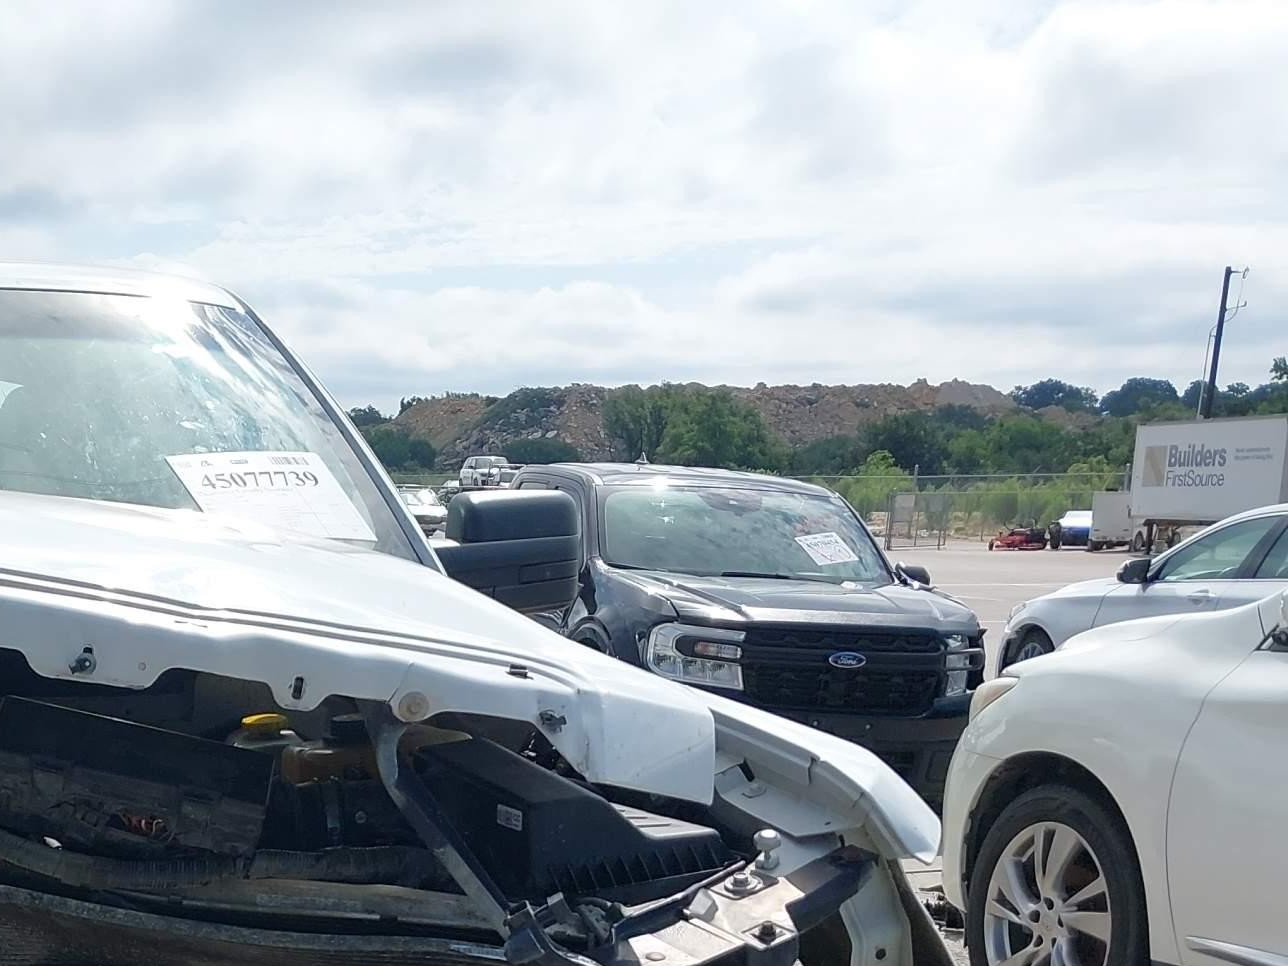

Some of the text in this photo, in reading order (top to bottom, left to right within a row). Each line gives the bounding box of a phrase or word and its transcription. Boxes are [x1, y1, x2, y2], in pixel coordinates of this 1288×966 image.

[1167, 444, 1227, 467] Builders
[201, 471, 319, 489] 45077739
[1165, 470, 1225, 487] FirstSource
